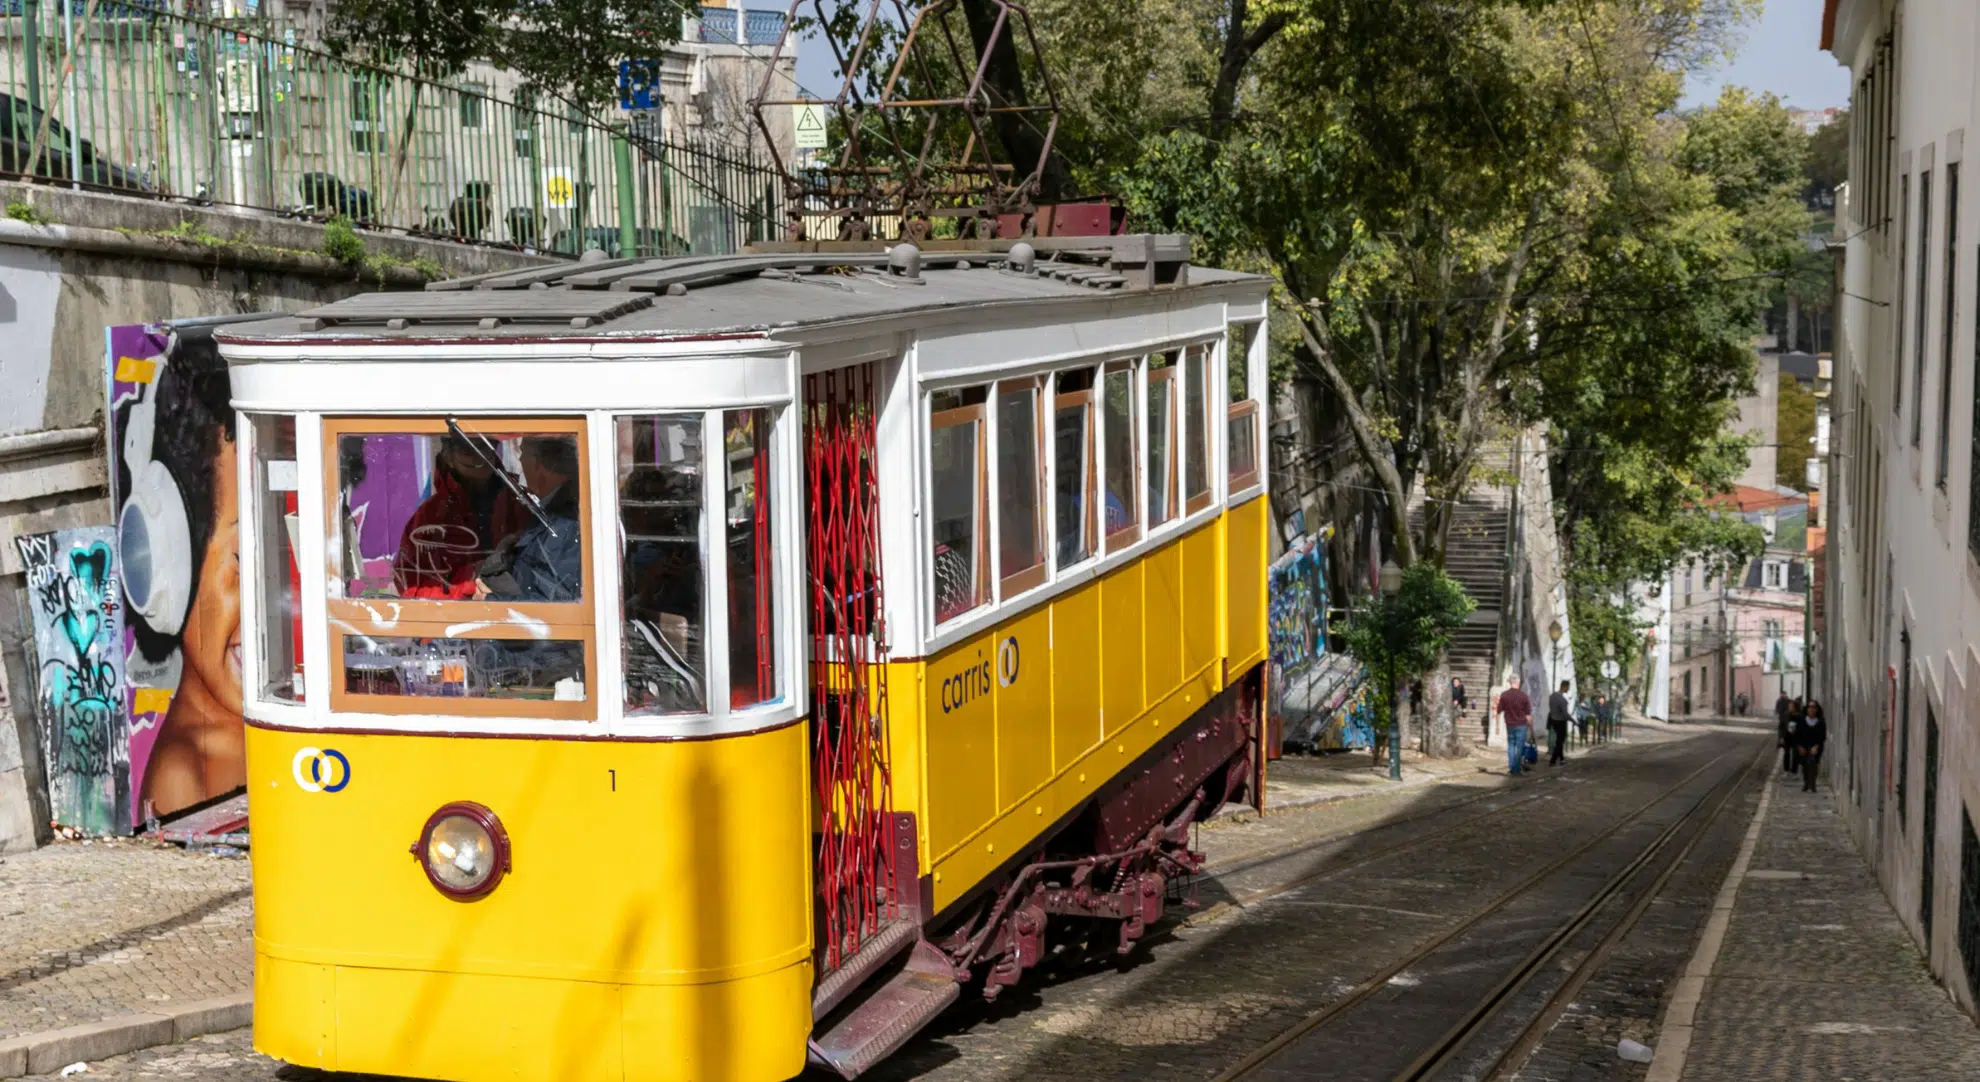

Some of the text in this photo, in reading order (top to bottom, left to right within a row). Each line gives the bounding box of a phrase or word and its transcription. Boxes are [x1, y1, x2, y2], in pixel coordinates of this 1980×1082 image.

[17, 534, 51, 568] MY
[942, 649, 991, 714] carris
[608, 769, 616, 792] 1
